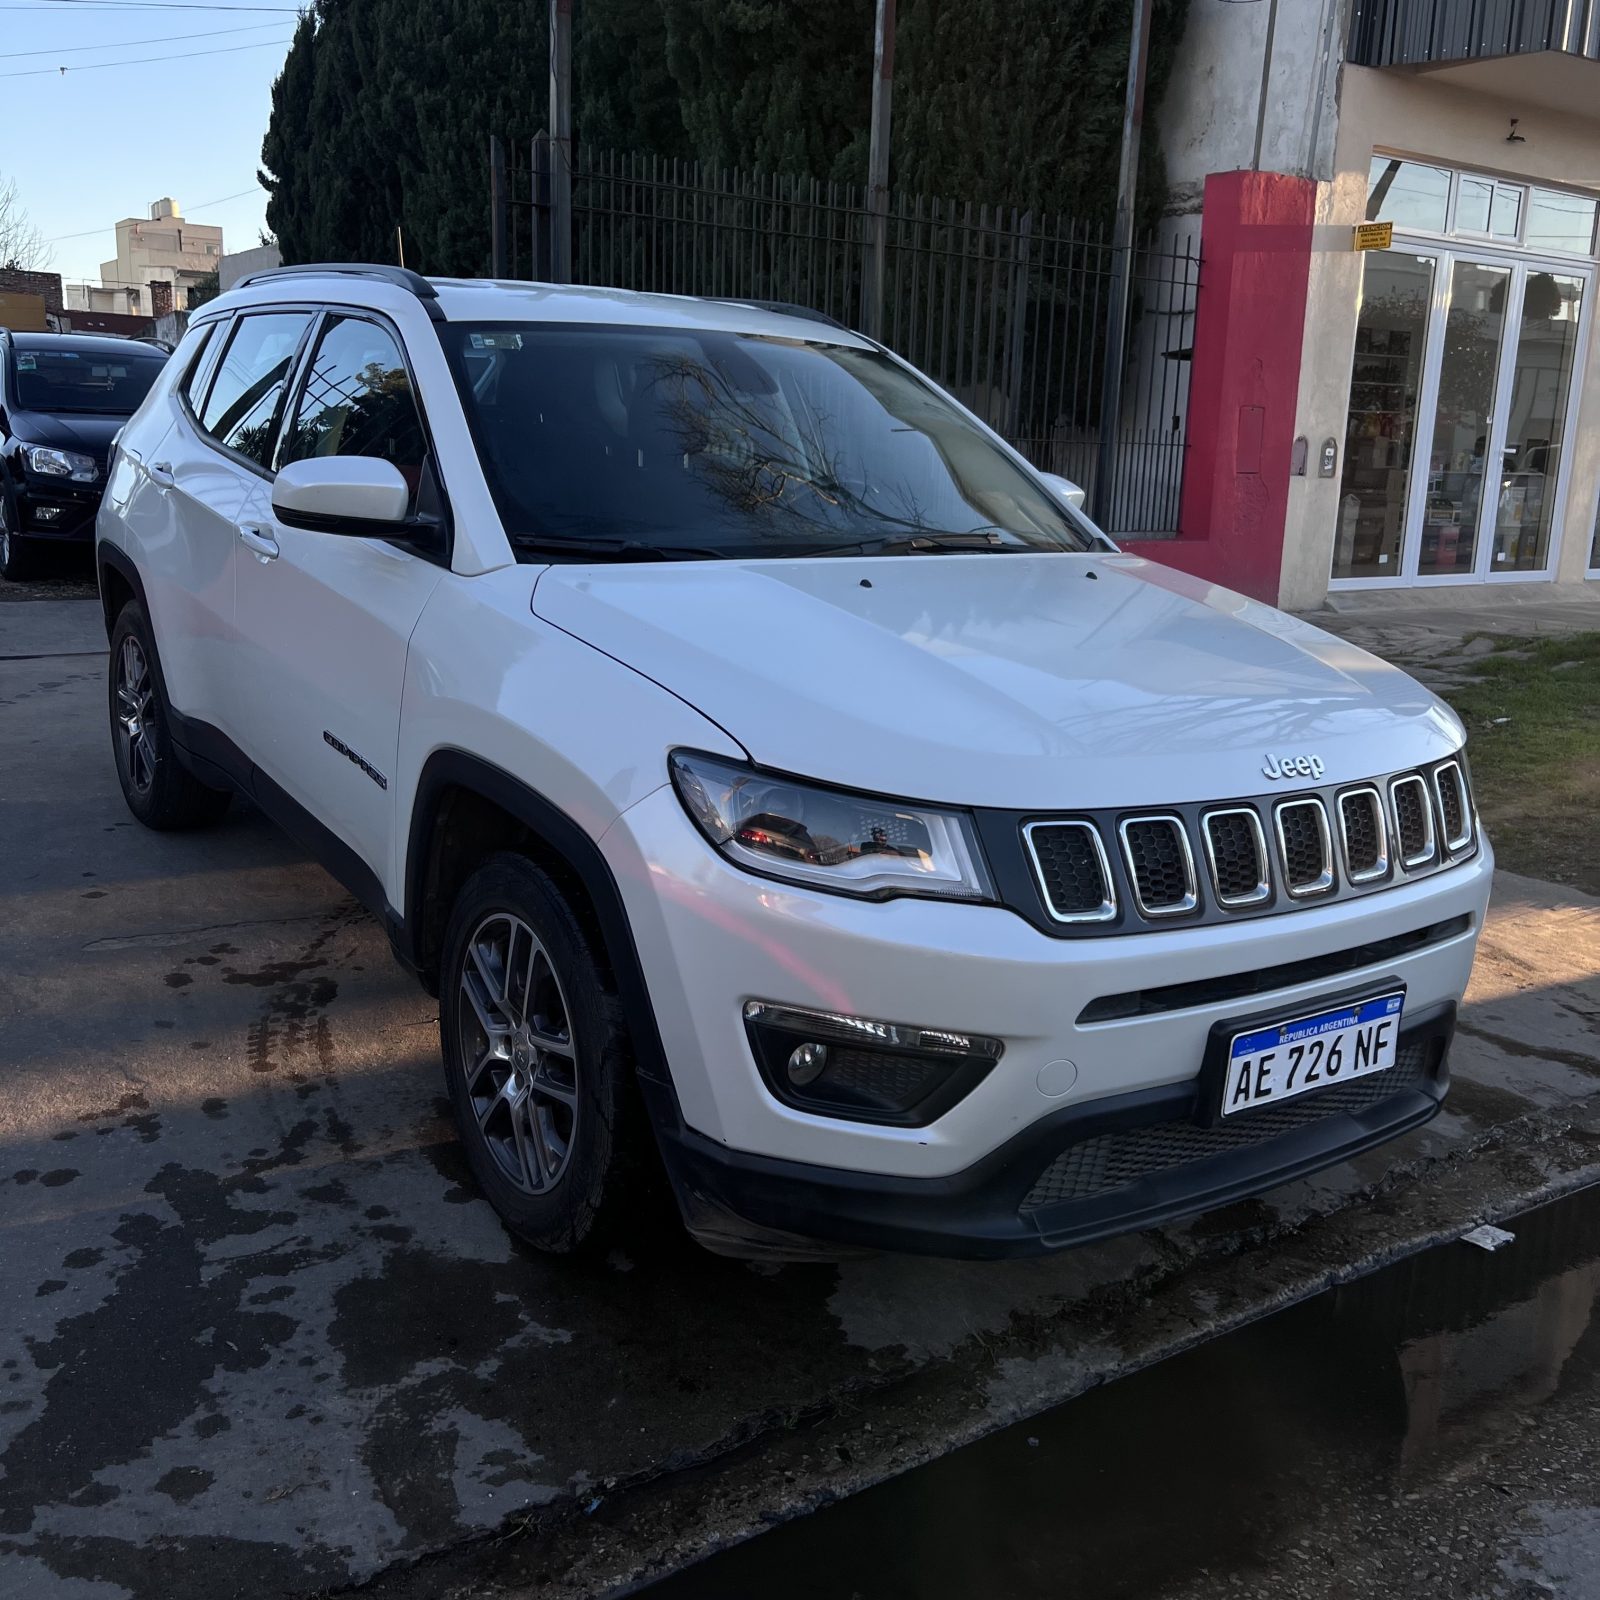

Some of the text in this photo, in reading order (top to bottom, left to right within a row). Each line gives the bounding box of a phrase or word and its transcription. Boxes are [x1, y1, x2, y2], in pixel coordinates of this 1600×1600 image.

[1261, 753, 1326, 780] Jeep
[1279, 1015, 1359, 1044] REPUBLICA ARGENTINA
[1232, 1021, 1392, 1105] AE 726 NF
